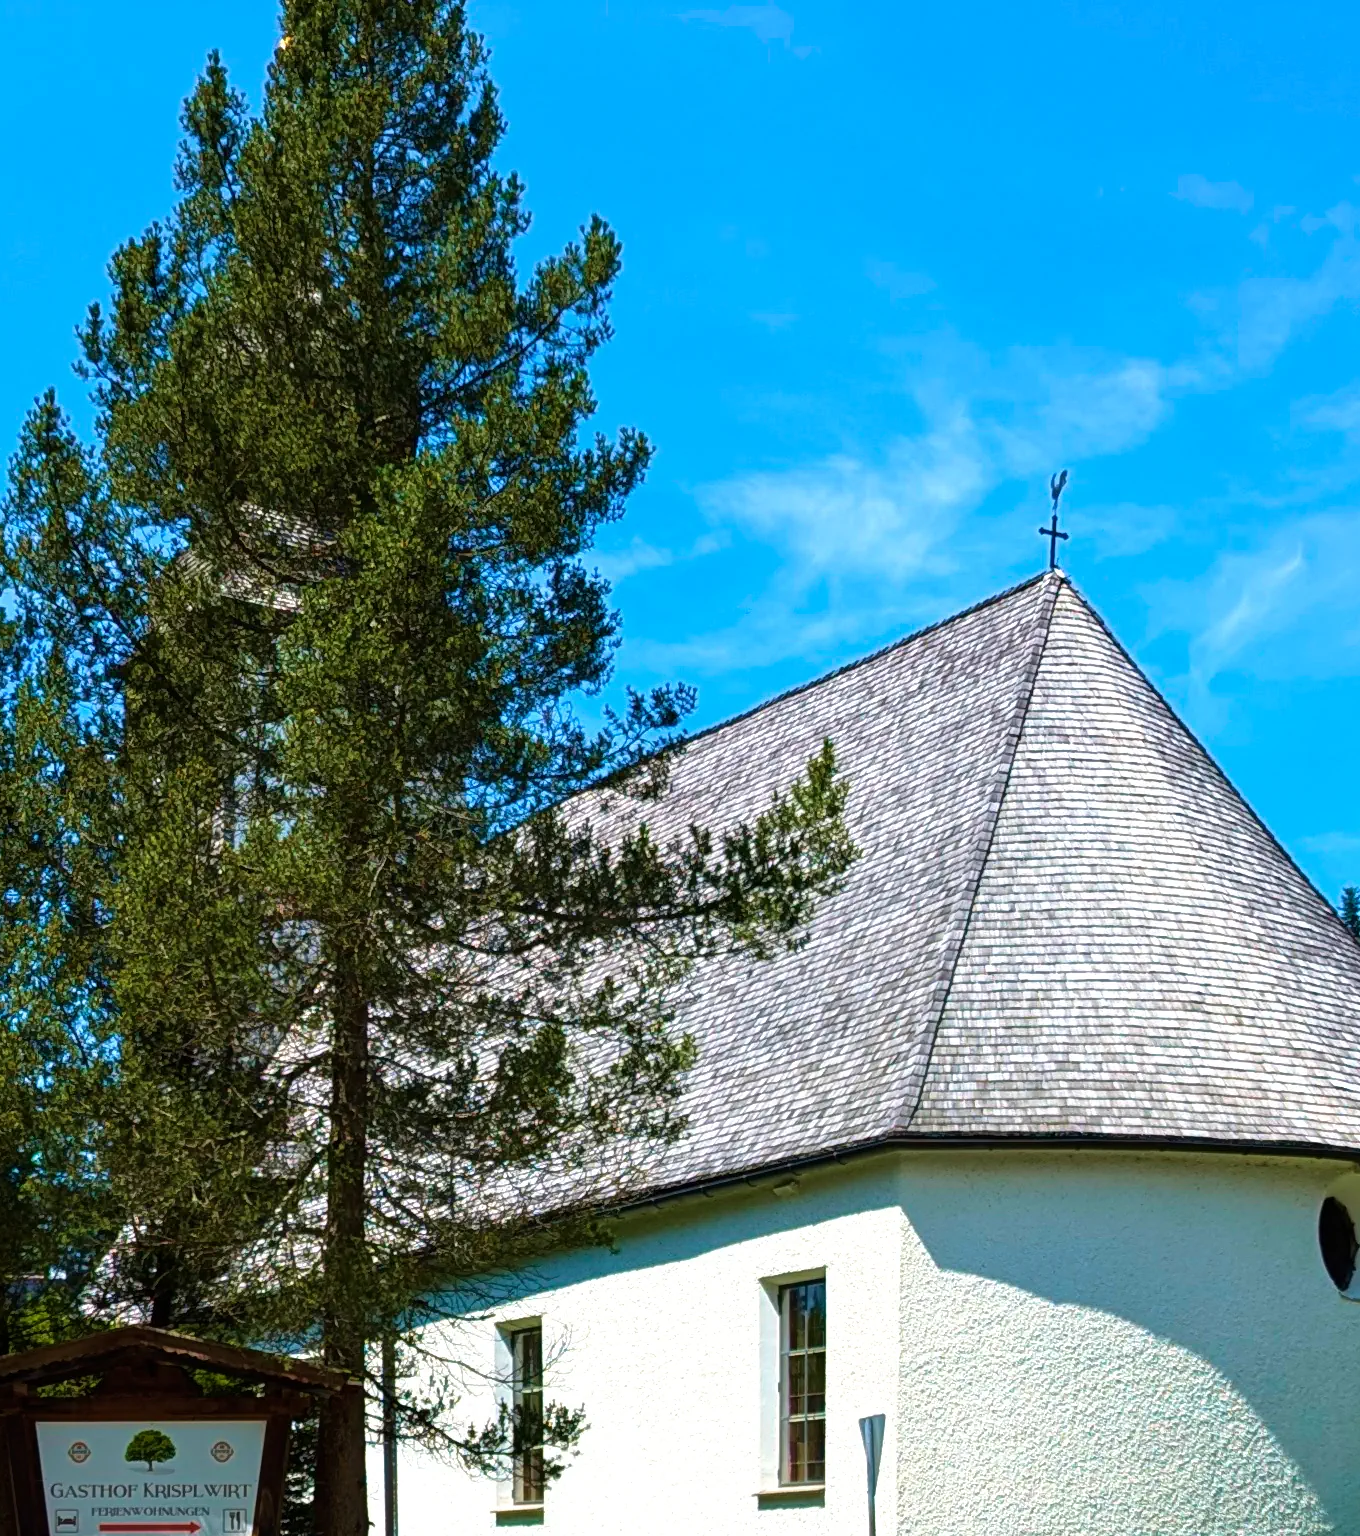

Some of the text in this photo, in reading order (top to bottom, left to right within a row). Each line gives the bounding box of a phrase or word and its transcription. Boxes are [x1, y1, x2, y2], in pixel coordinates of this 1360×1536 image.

[50, 1482, 252, 1500] GASTHOF KRISPLWIRT
[91, 1506, 210, 1518] FERIENWOHNUNGEN
